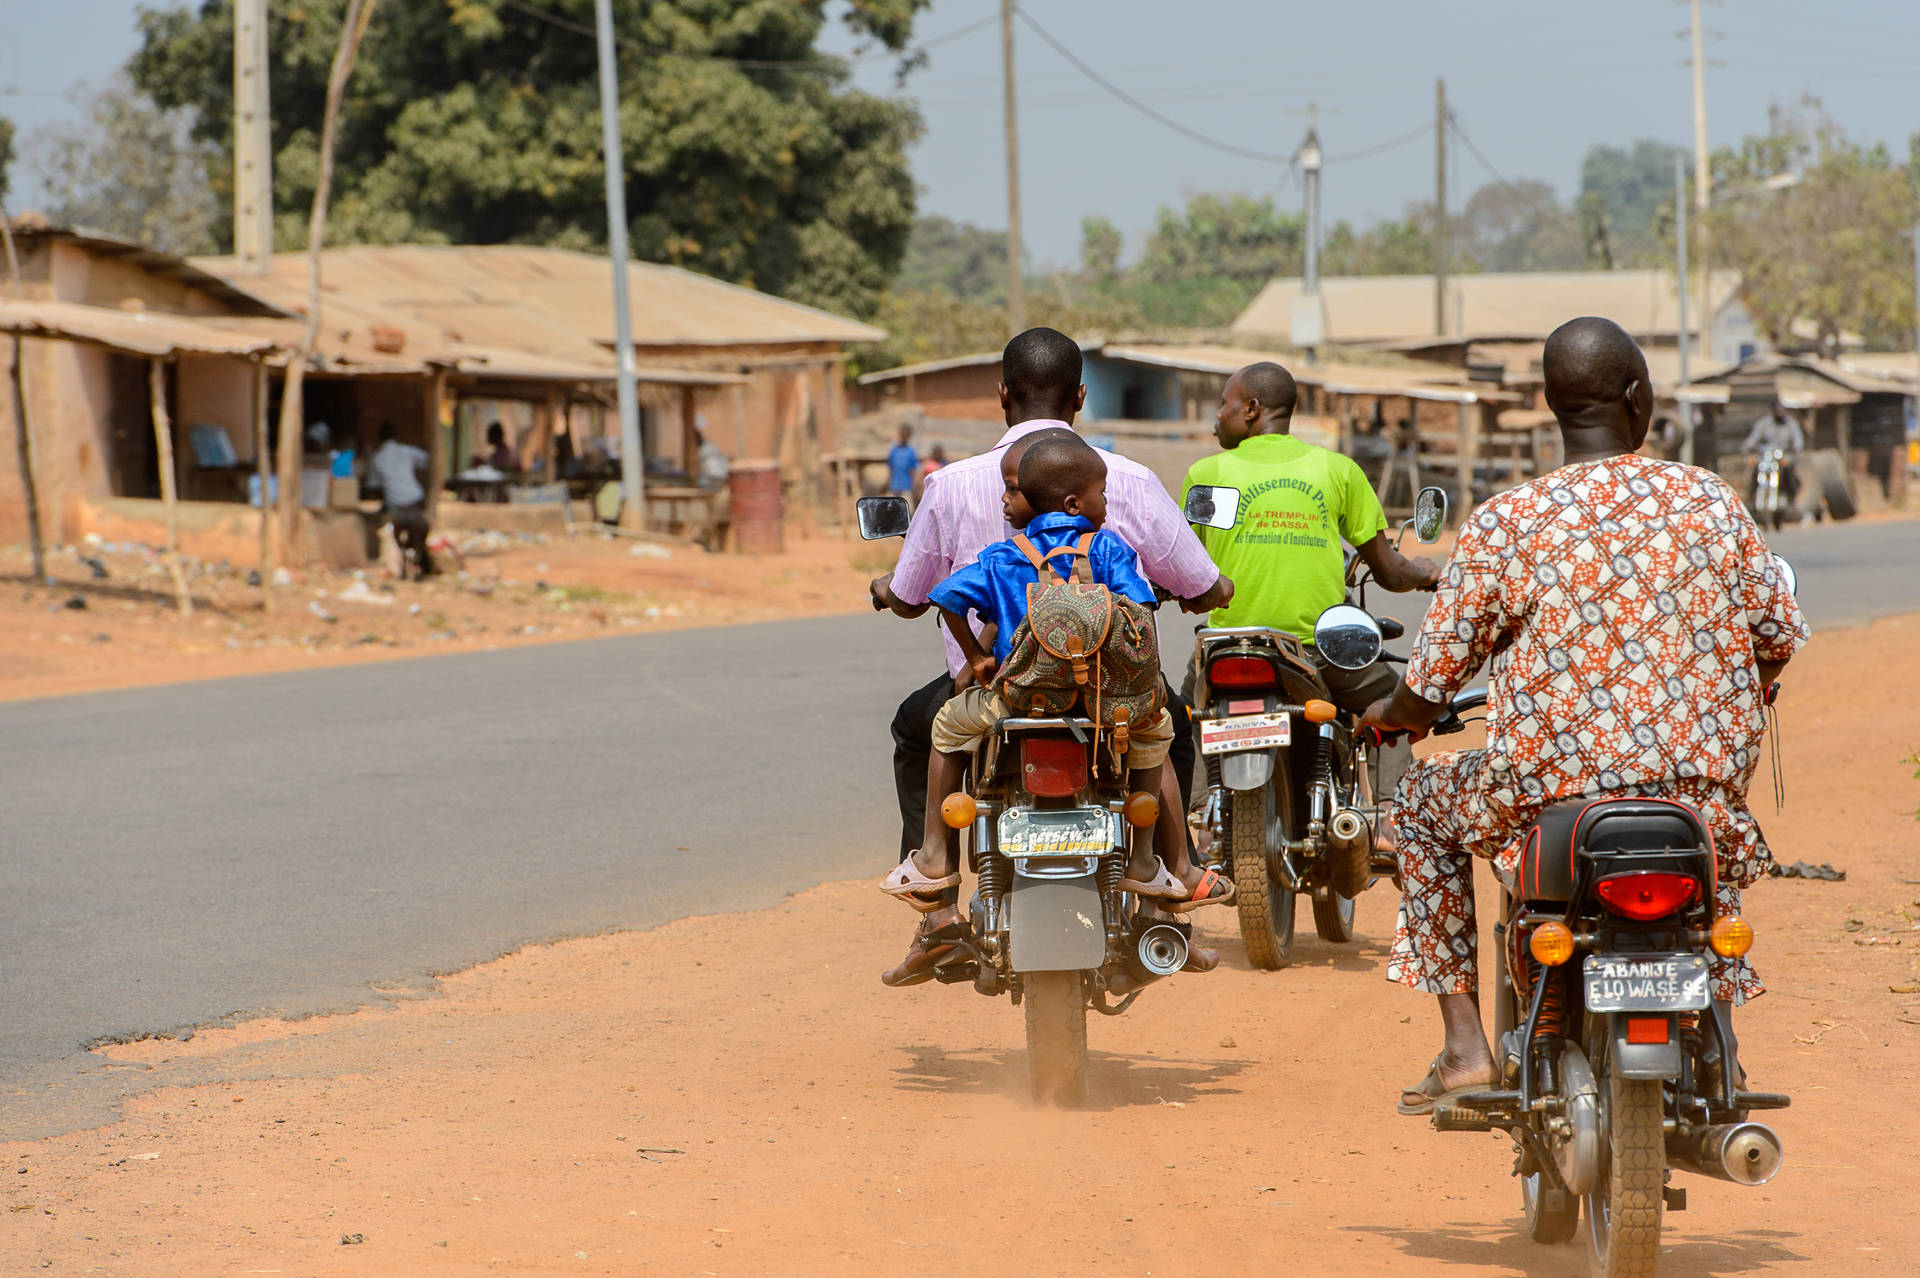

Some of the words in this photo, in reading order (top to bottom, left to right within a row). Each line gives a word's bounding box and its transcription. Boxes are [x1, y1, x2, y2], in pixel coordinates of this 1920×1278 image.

[1264, 510, 1319, 521] TREMPLIN
[1256, 520, 1269, 529] de
[1272, 520, 1310, 530] DASSA
[1244, 531, 1281, 545] Formation
